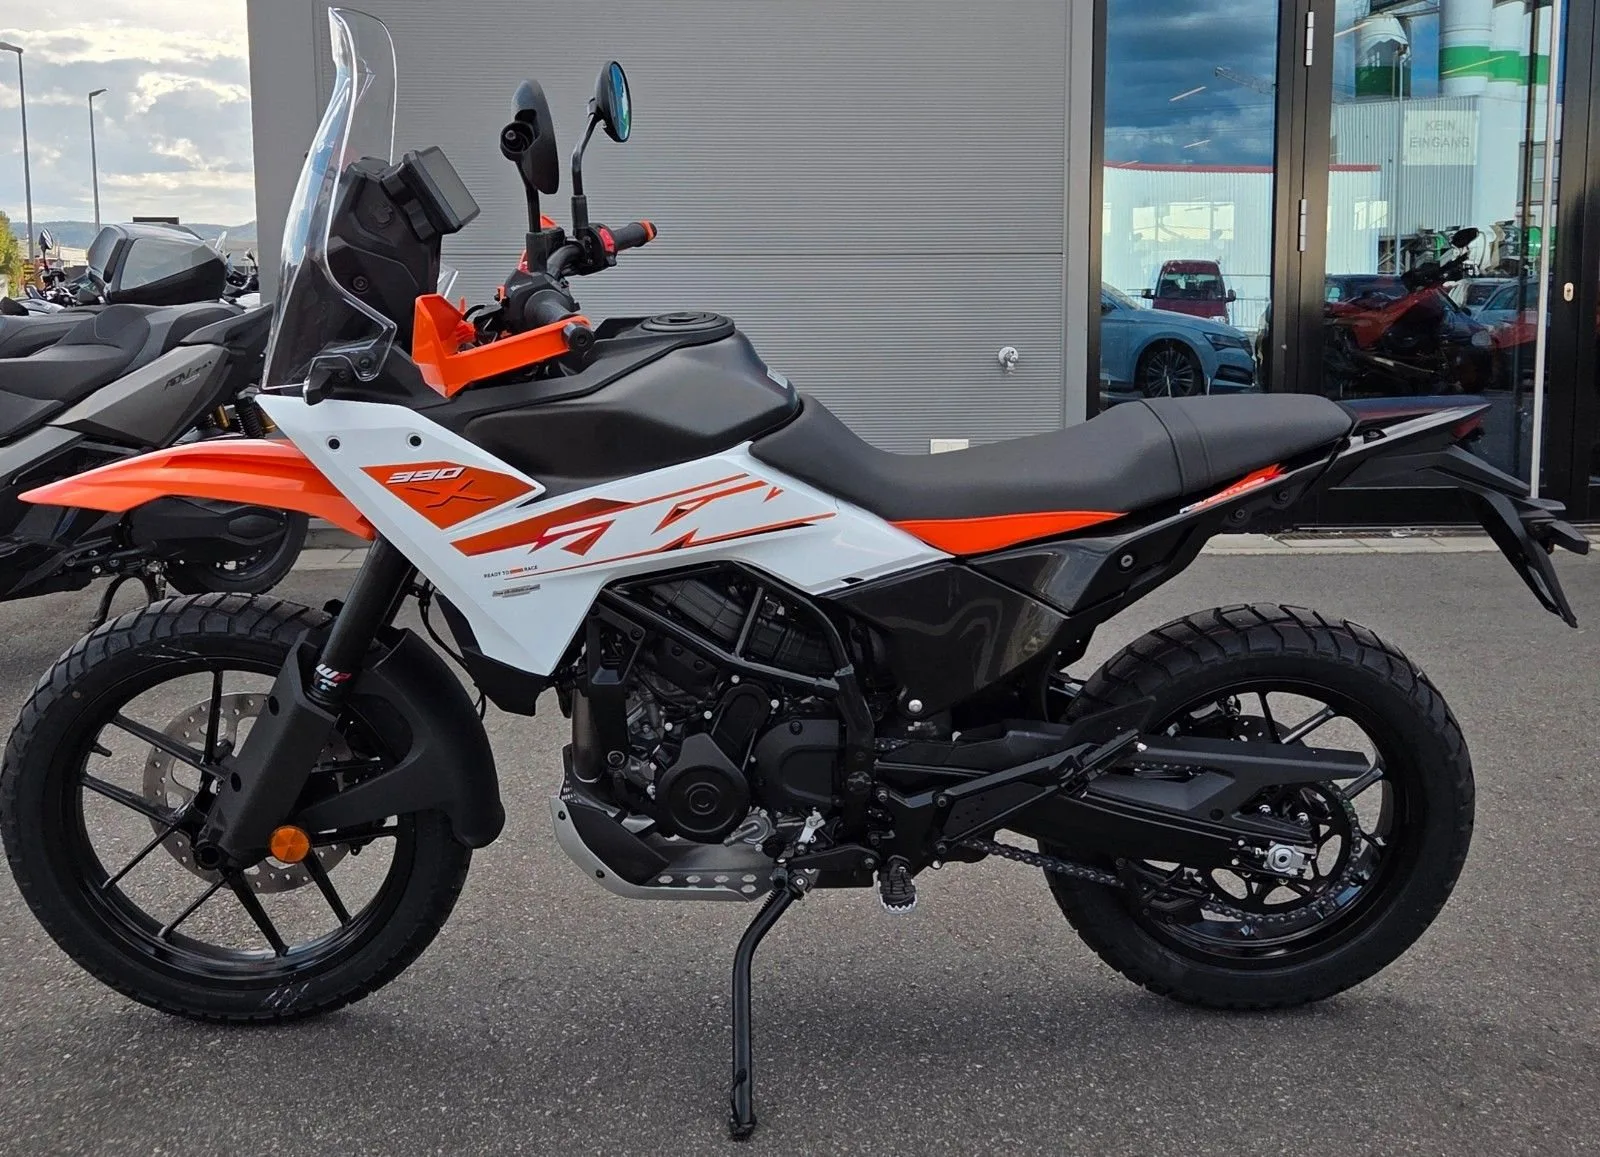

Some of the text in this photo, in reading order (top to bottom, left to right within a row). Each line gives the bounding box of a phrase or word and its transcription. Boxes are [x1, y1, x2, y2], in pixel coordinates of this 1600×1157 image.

[1425, 119, 1456, 132] KEIN
[1409, 135, 1470, 148] EINGANG
[385, 466, 467, 484] 390
[483, 570, 501, 578] READY
